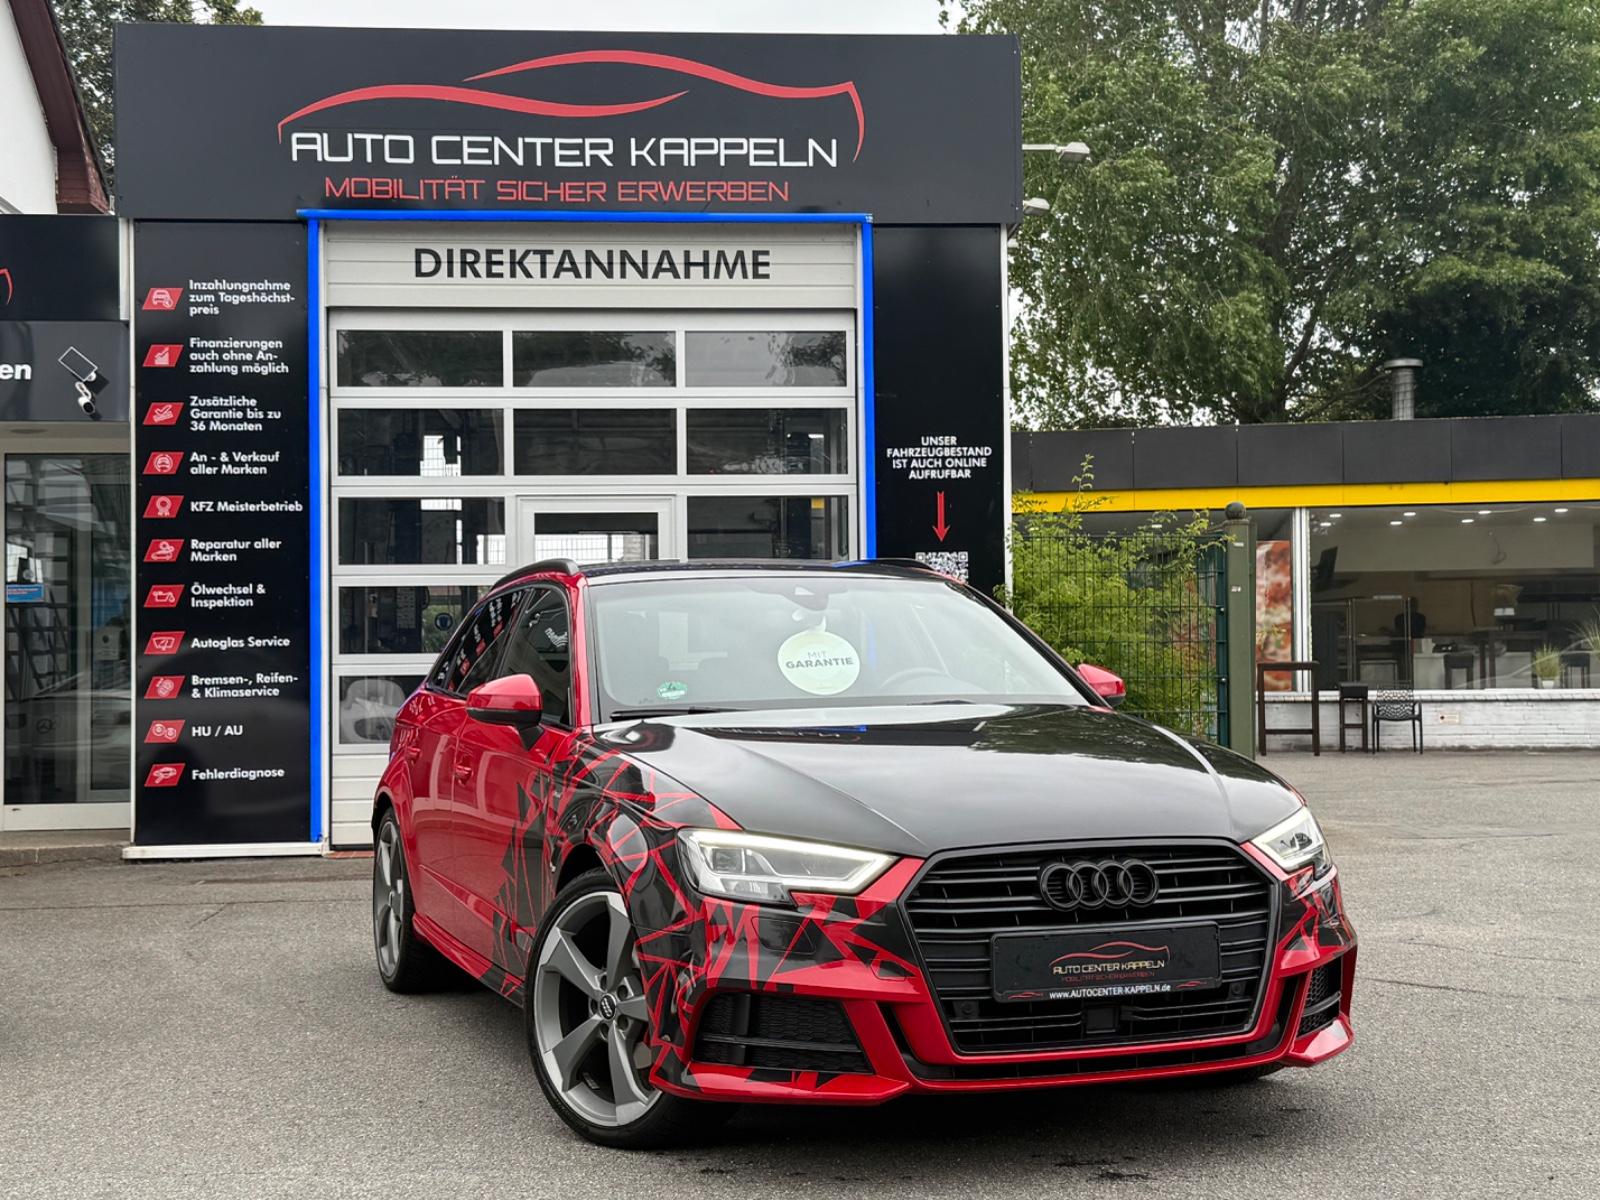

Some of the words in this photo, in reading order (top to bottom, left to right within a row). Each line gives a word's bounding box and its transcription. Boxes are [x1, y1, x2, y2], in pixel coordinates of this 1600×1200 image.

[292, 133, 414, 164] AUTO
[432, 136, 613, 166] CENTER
[631, 138, 837, 168] KAPPELN
[325, 176, 485, 200] MOBILITÄT
[497, 180, 606, 202] SICHER
[619, 182, 789, 202] ERWERBEN
[415, 247, 770, 280] DIREKTANNAHME
[189, 279, 291, 292] Inzahlungnahme
[189, 294, 215, 303] zum
[219, 292, 296, 306] Tageshöchst-
[189, 305, 220, 317] preis
[189, 337, 283, 351] Finanzierungen
[189, 350, 220, 361] auch
[222, 350, 253, 361] ohne
[256, 350, 278, 361] An-
[189, 362, 239, 376] zahlung
[241, 362, 290, 376] möglich
[189, 395, 257, 407] Zusätzliche
[190, 407, 244, 419] Garantie
[246, 407, 264, 419] bis
[267, 410, 282, 419] zu
[190, 421, 206, 432] 36
[209, 421, 263, 432] Monaten
[921, 436, 957, 446] UNSER
[219, 452, 230, 463] &
[232, 451, 281, 463] Verkauf
[886, 447, 992, 458] FAHRZEUGBESTAND
[190, 464, 219, 475] aller
[221, 463, 268, 475] Marken
[892, 458, 908, 469] IST
[910, 458, 943, 468] AUCH
[945, 457, 987, 468] ONLINE
[908, 468, 972, 480] AUFRUFBAR
[190, 501, 214, 512] KFZ
[217, 500, 303, 512] Meisterbetrieb
[190, 538, 251, 552] Reparatur
[254, 537, 282, 549] aller
[190, 551, 238, 562] Marken
[190, 581, 253, 595] Ölwechsel
[256, 584, 267, 595] &
[190, 596, 254, 610] Inspektion
[190, 637, 245, 651] Autoglas
[247, 636, 291, 648] Service
[785, 657, 854, 669] GARANTIE
[191, 674, 253, 686] Bremsen-,
[256, 672, 299, 684] Reifen-
[191, 687, 202, 699] &
[204, 685, 280, 698] Klimaservice
[191, 726, 212, 737] HU
[214, 725, 222, 738] /
[224, 725, 244, 736] AU
[191, 768, 286, 780] Fehlerdiagnose
[1053, 965, 1081, 975] AUTO
[1082, 963, 1120, 973] CENTER
[1121, 960, 1165, 970] KAPPELN
